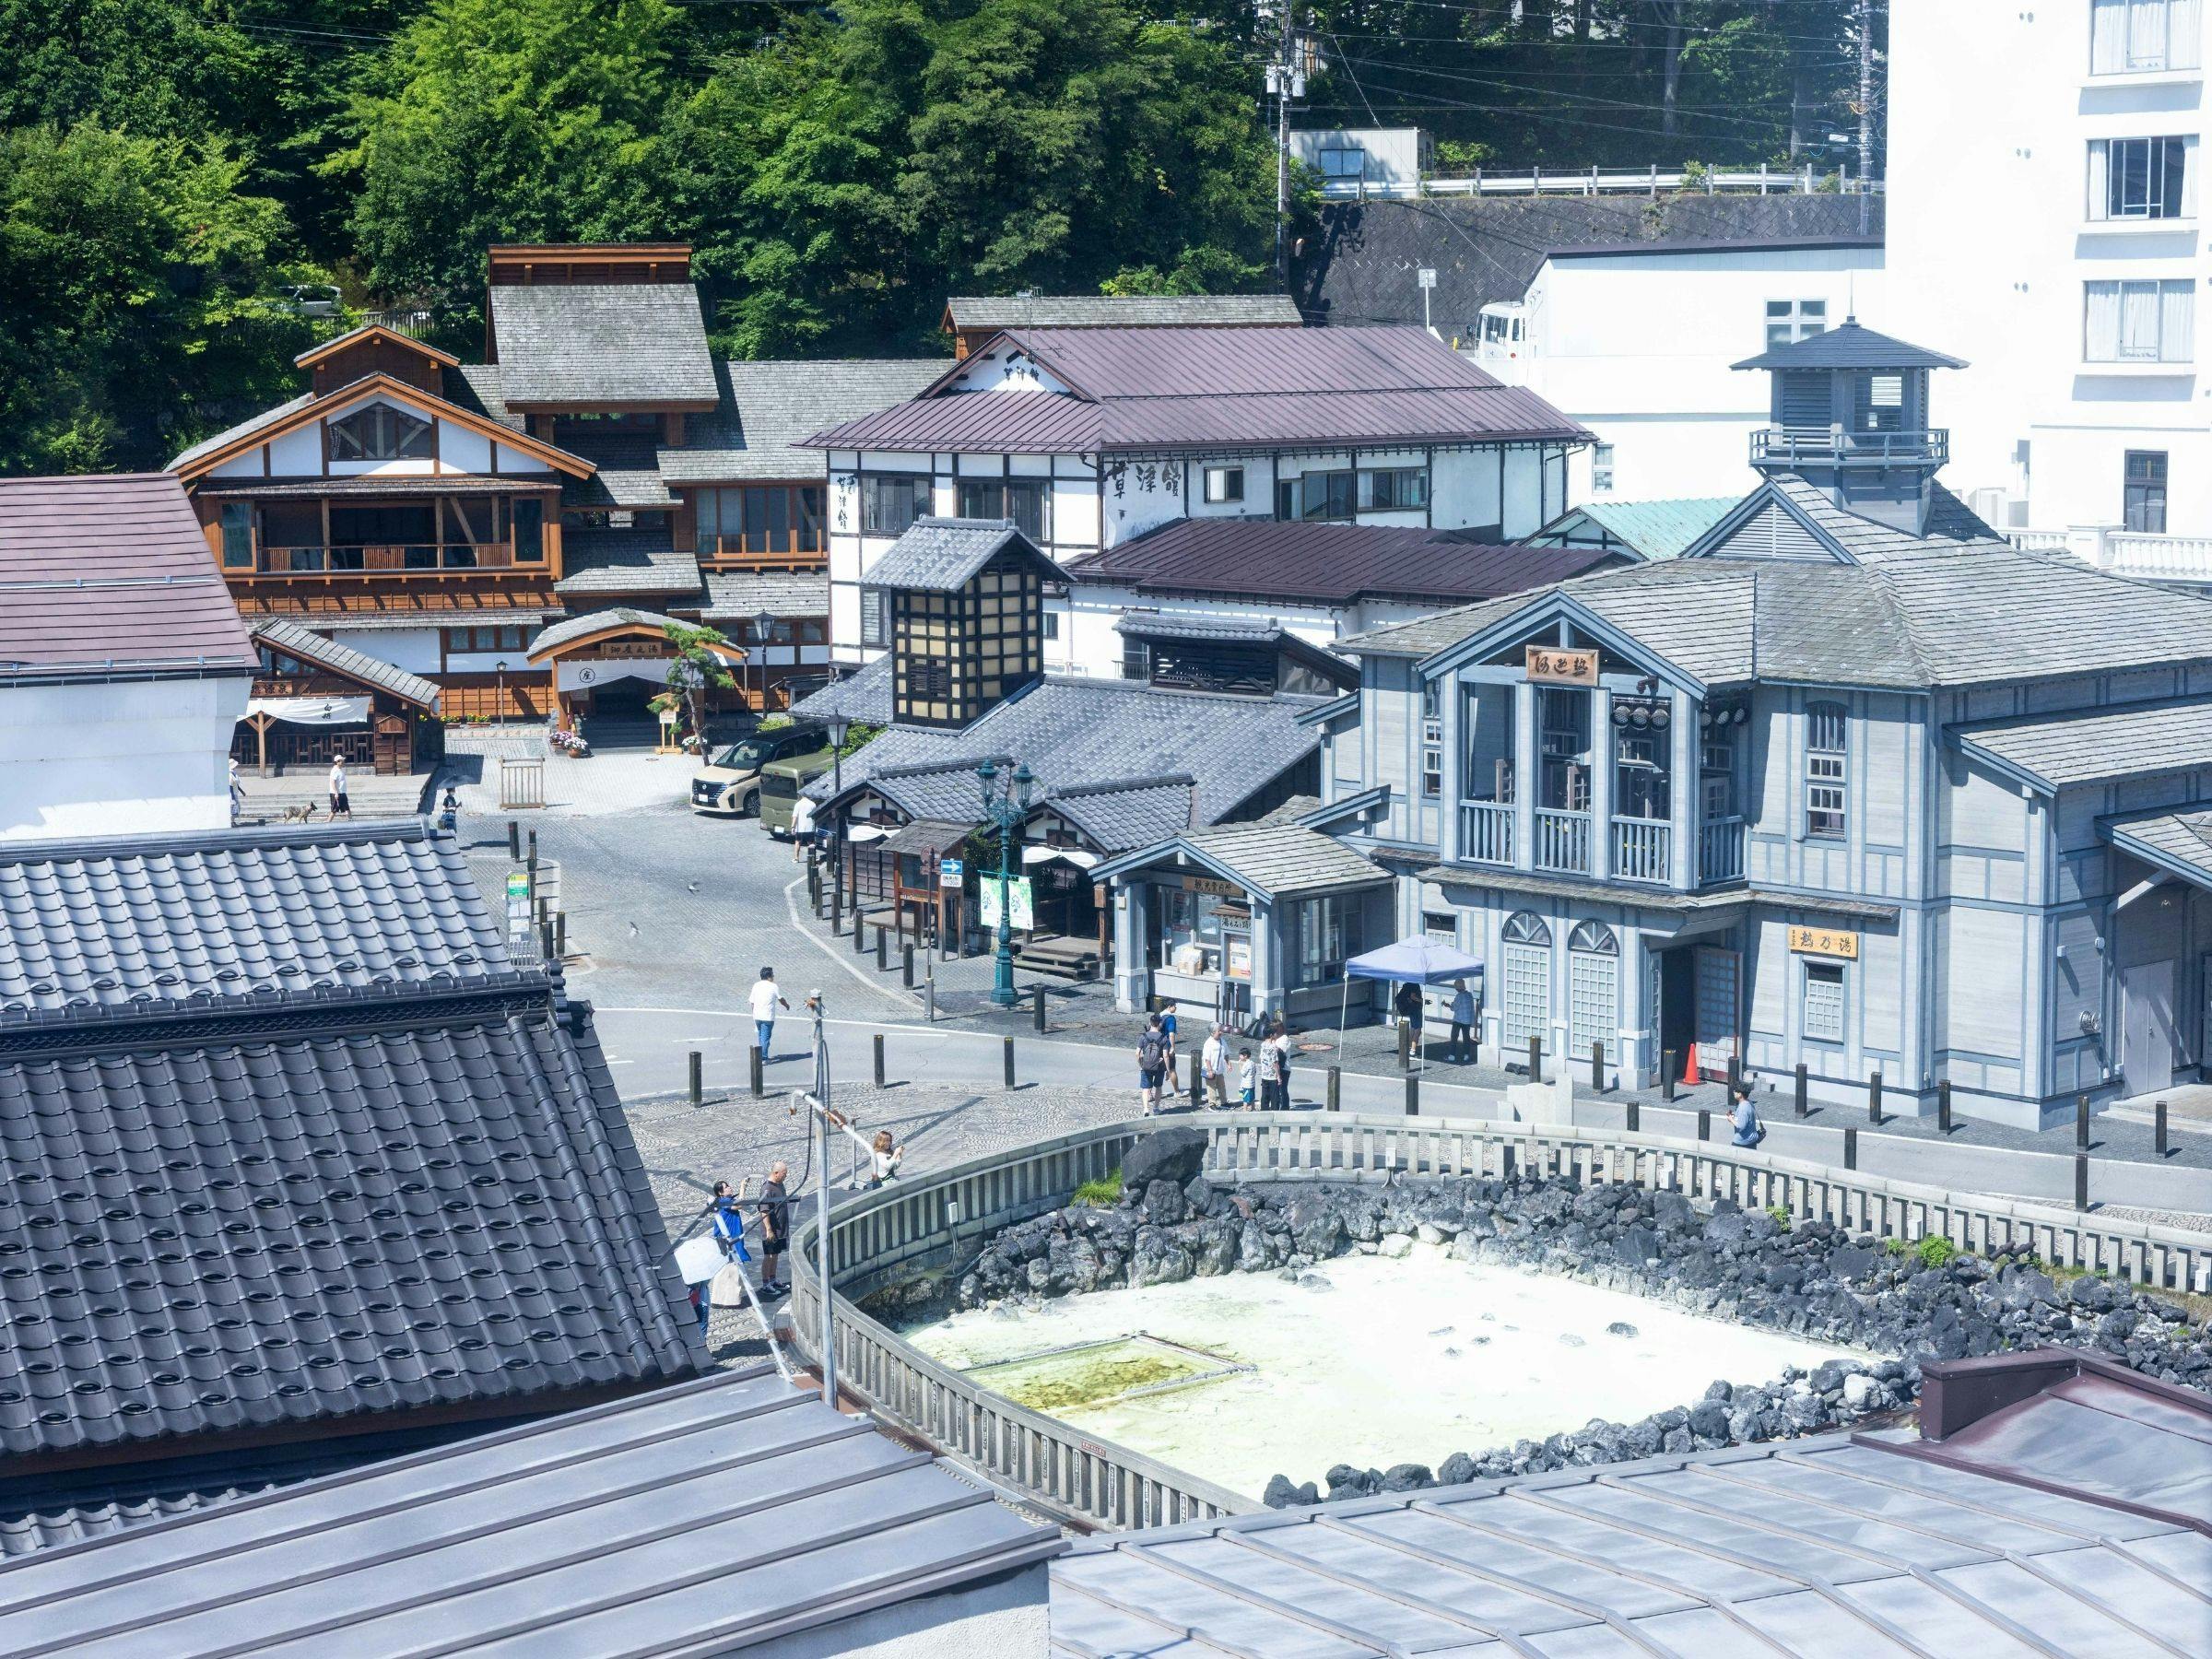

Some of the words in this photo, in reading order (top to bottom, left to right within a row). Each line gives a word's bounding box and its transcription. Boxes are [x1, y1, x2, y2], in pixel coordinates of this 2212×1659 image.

[1105, 460, 1182, 499] 草津館
[836, 476, 848, 530] 草津館
[1194, 878, 1232, 893] 観光案内所
[1800, 930, 1852, 953] 熱乃湯
